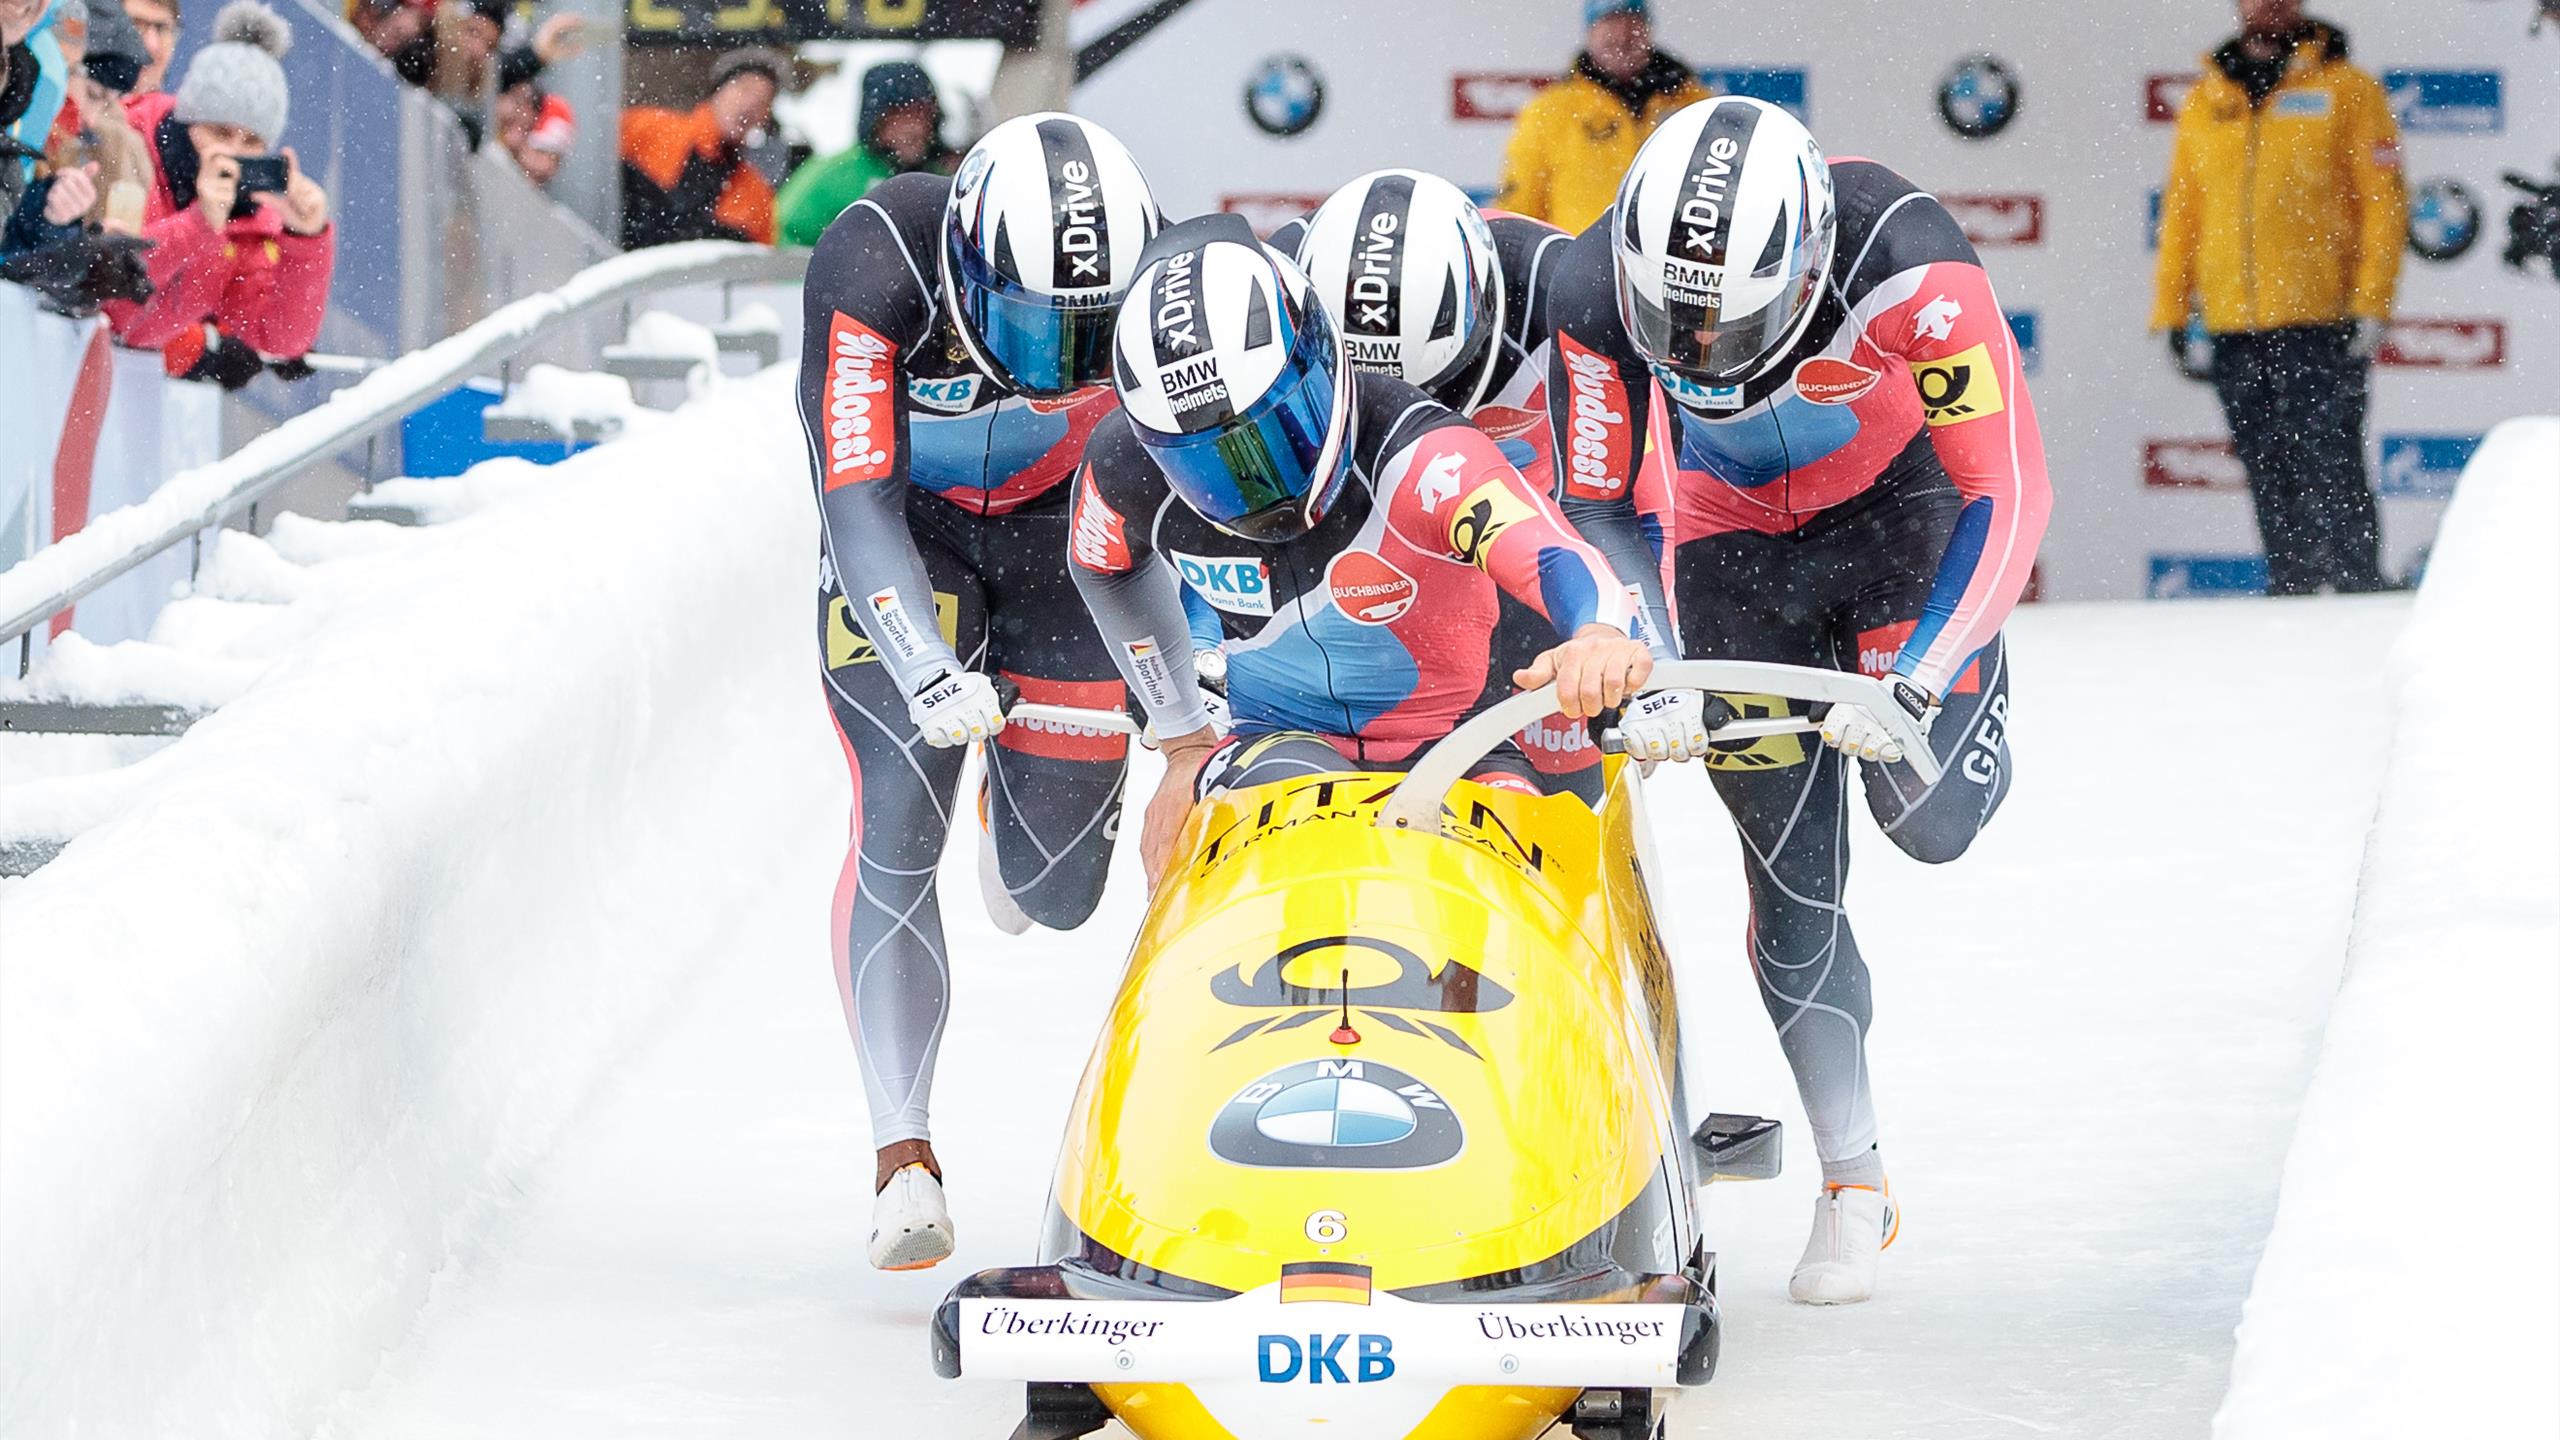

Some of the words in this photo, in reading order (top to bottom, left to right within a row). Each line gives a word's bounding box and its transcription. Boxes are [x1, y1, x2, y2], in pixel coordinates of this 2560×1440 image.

[1680, 137, 1738, 257] xDrive
[1061, 160, 1099, 278] xDrive
[1353, 212, 1398, 327] xDrive
[1664, 262, 1724, 288] BMW
[1051, 292, 1110, 311] BMW
[1157, 250, 1199, 351] xDrive
[1663, 284, 1721, 309] helmets
[1160, 357, 1218, 395] BMW
[830, 331, 887, 474] Nudossi
[1169, 380, 1228, 416] helmets
[1565, 350, 1623, 491] Nudossi
[1178, 558, 1263, 595] DKB
[1333, 580, 1410, 599] BUCHBINDER
[881, 612, 915, 658] Sporthilfe
[1135, 657, 1165, 706] Sporthilfe
[1642, 695, 1680, 715] SEIZ
[1200, 810, 1357, 879] GERMAN
[1236, 1059, 1447, 1110] BMW
[1304, 1209, 1348, 1244] 6
[979, 1306, 1165, 1346] Überkinger
[1476, 1312, 1666, 1346] Überkinger
[1257, 1332, 1395, 1385] DKB
